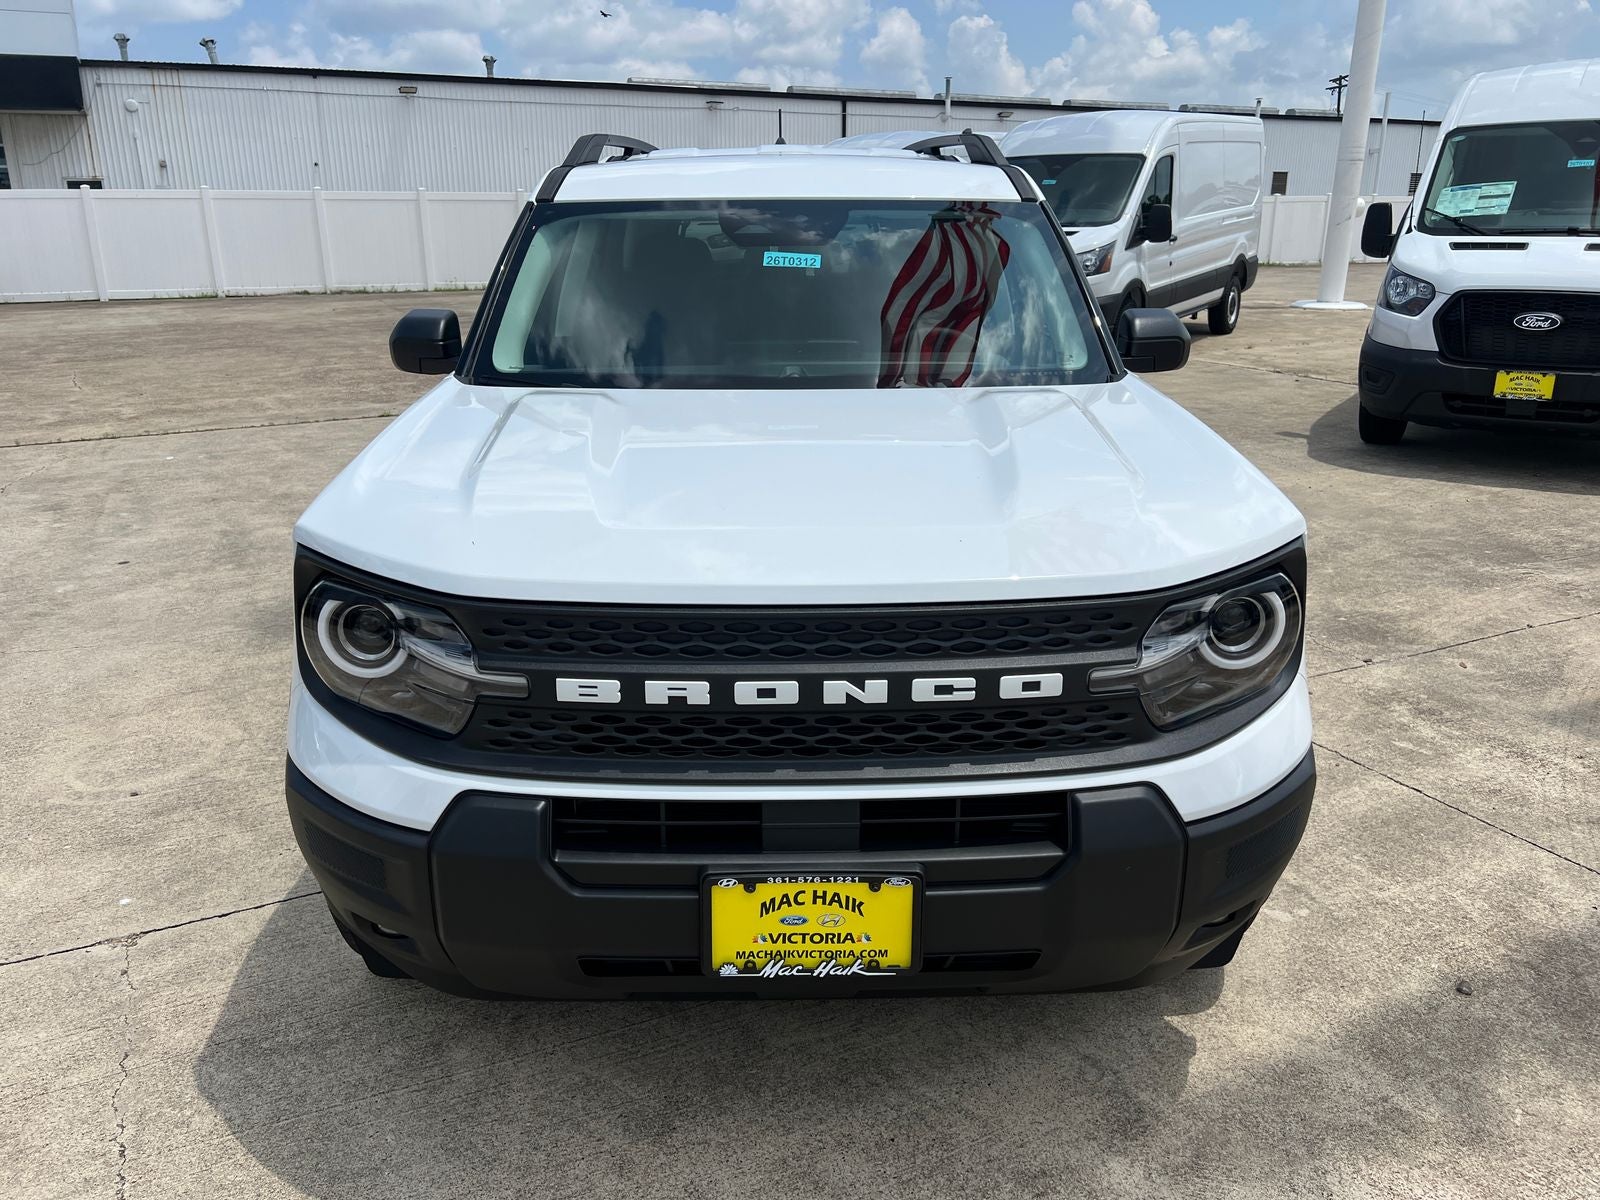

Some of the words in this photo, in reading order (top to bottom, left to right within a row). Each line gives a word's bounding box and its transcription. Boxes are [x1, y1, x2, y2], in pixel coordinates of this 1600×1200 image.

[766, 255, 817, 267] 26T0312
[1521, 315, 1552, 328] Ford
[555, 672, 1064, 705] BRONCO
[767, 876, 860, 884] 361-576-1221
[759, 889, 806, 918] MAC
[811, 889, 865, 917] HAIK
[768, 932, 856, 945] VICTORIA
[735, 949, 889, 960] MACHAIKVICTORIA.COM
[758, 958, 811, 979] Mac
[812, 958, 868, 978] Haik
